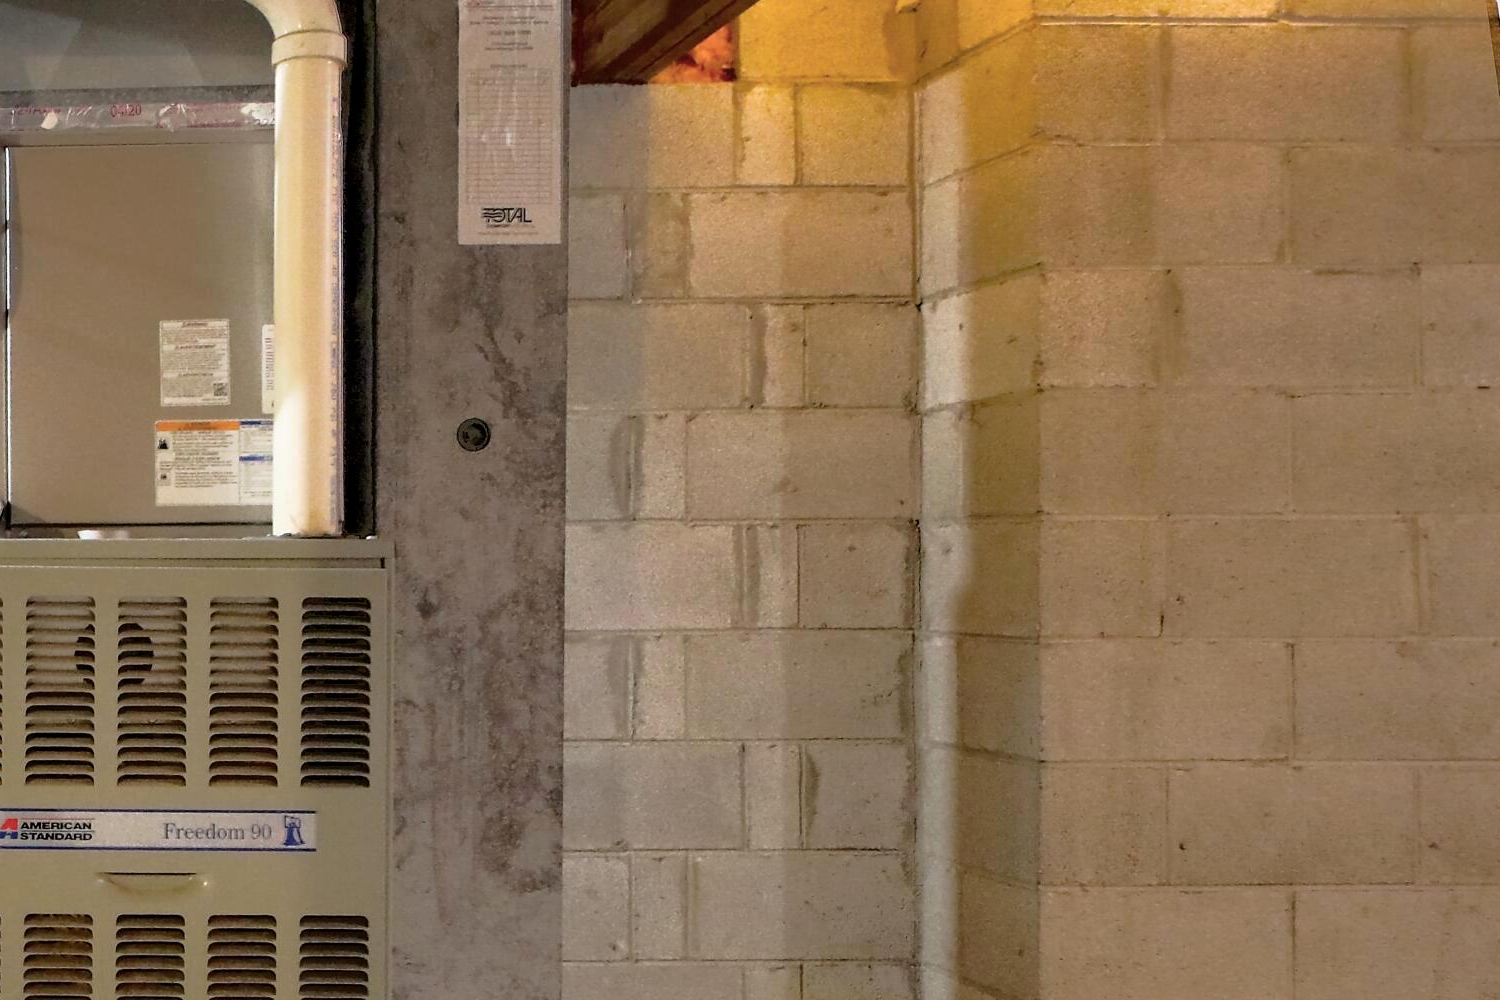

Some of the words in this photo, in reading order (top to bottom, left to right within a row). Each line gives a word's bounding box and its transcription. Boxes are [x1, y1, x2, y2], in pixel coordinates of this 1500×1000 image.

[482, 207, 533, 223] TOTAL
[21, 821, 92, 830] AMERICAN
[163, 822, 245, 840] Freedom
[251, 823, 272, 840] 90
[20, 832, 93, 841] STANDARD
